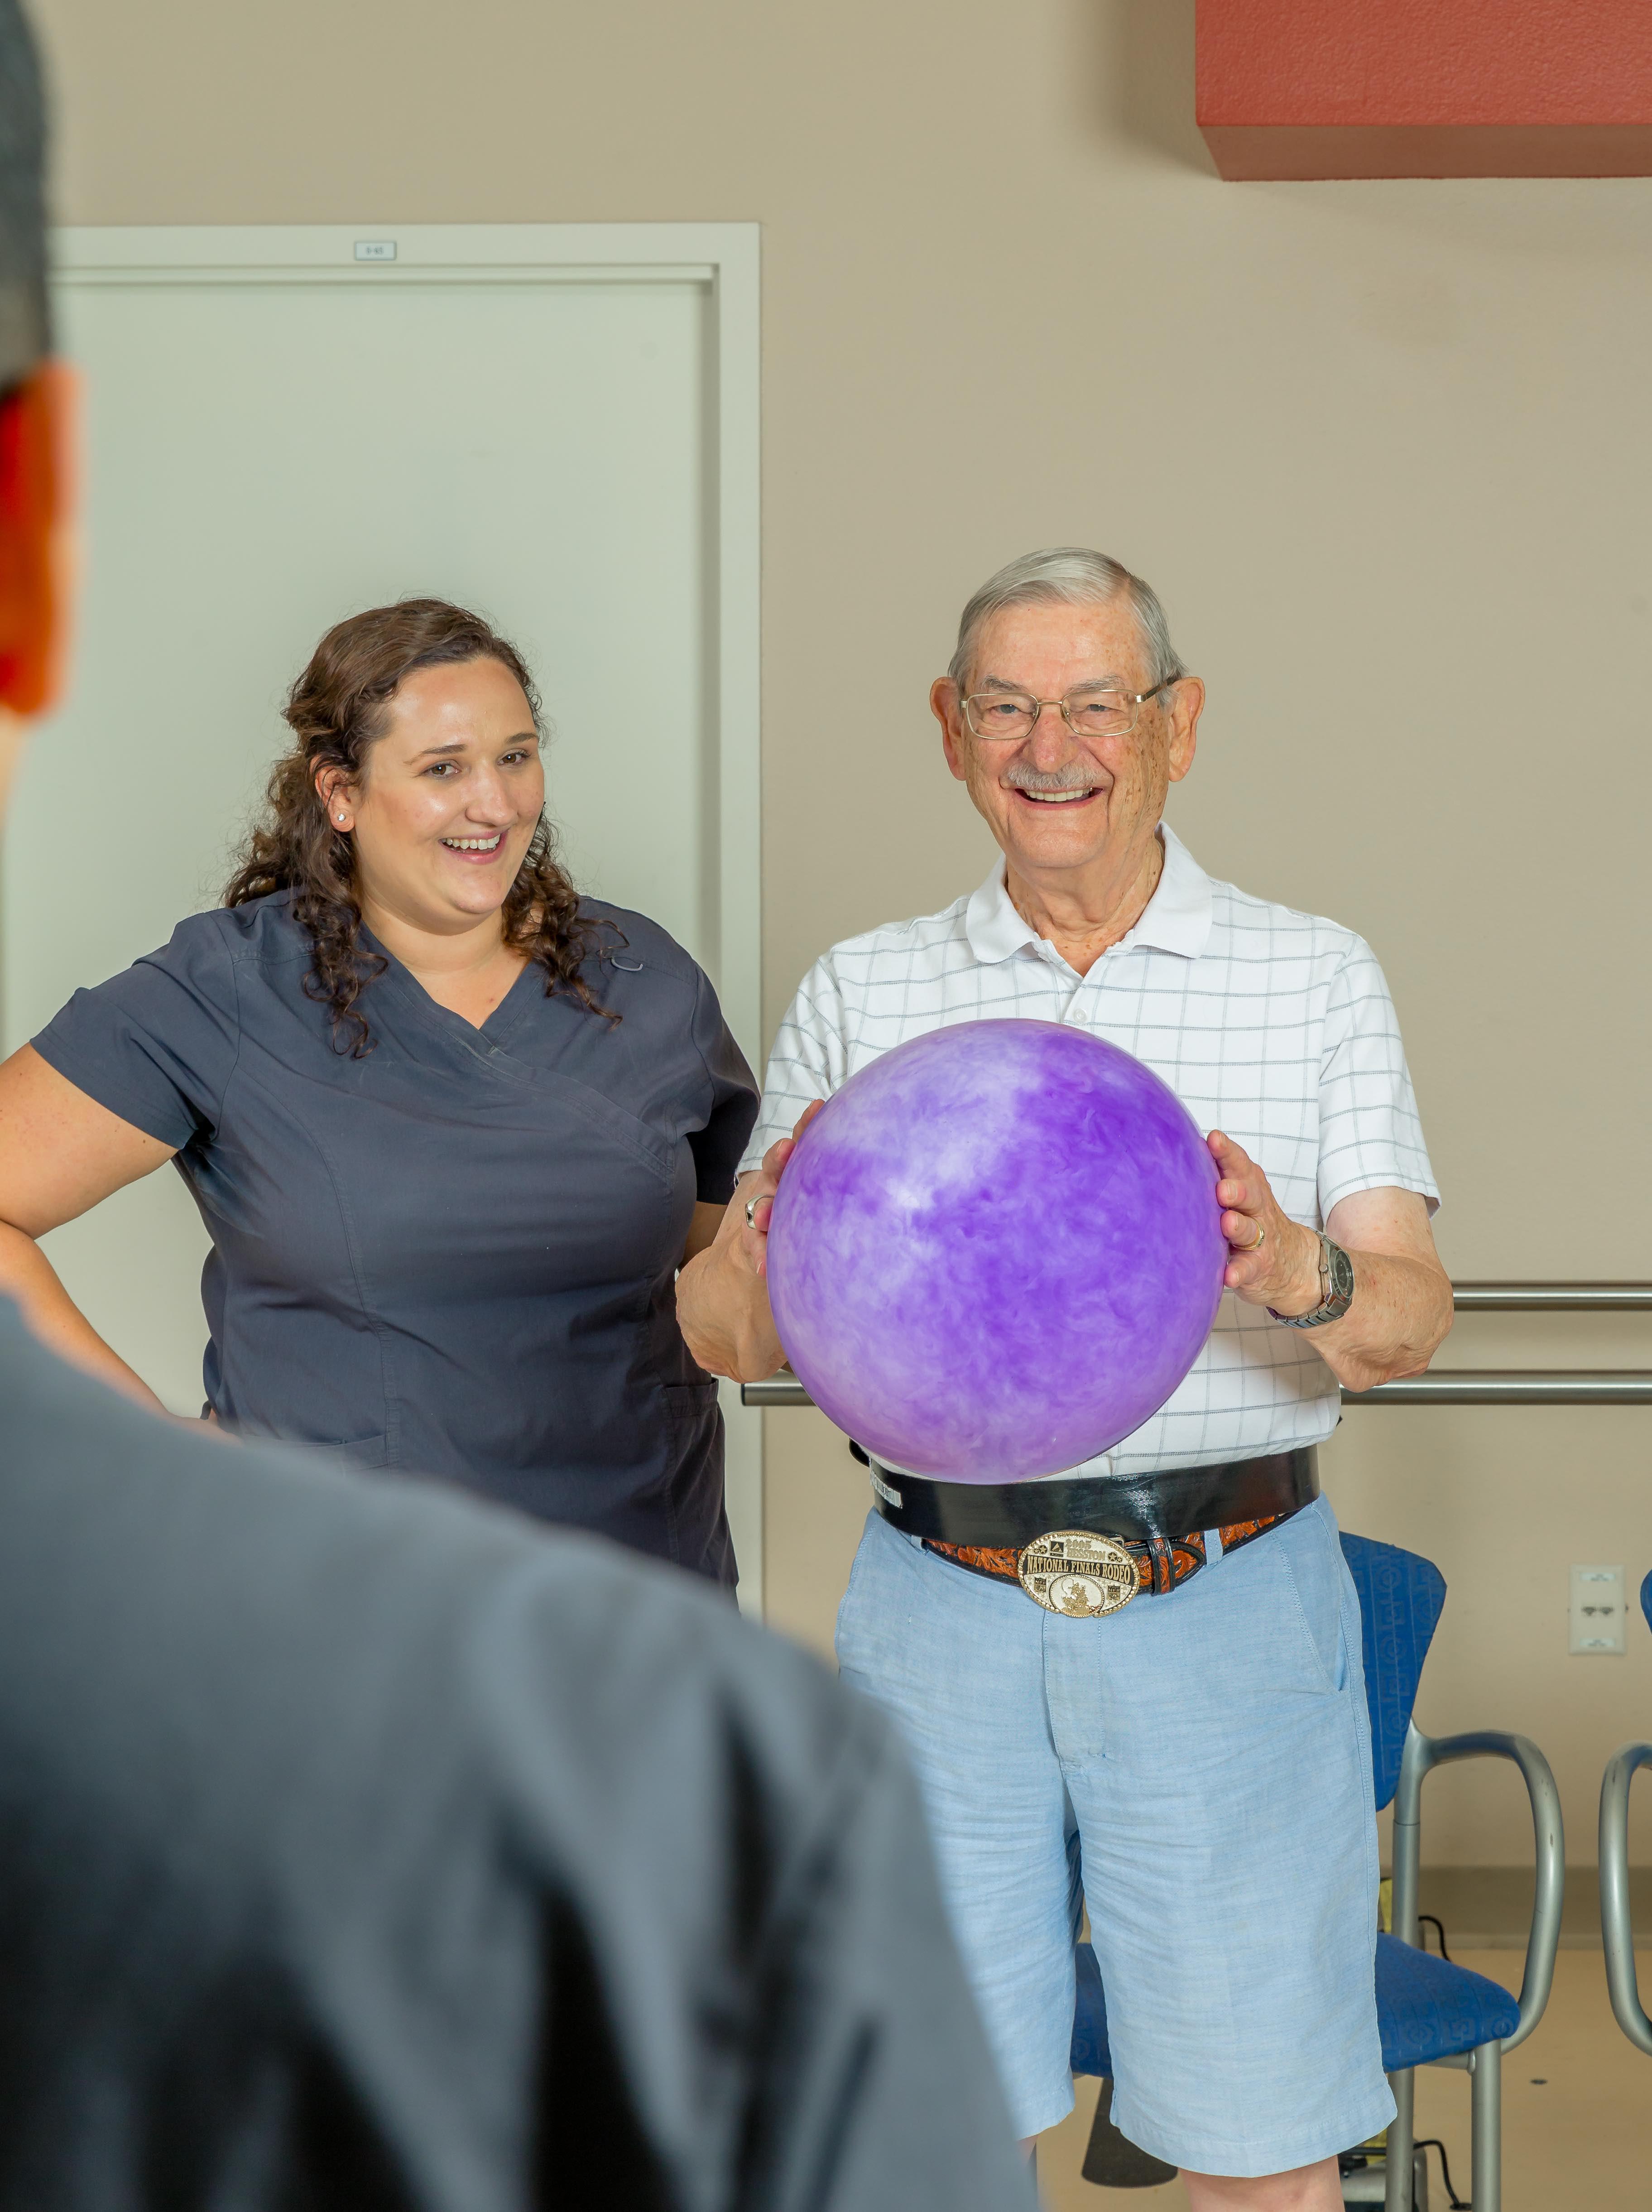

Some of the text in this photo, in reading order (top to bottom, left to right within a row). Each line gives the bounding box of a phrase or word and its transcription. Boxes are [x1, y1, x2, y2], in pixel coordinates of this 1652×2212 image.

[1027, 1555, 1130, 1585] NATIONAL FINALS RODEO
